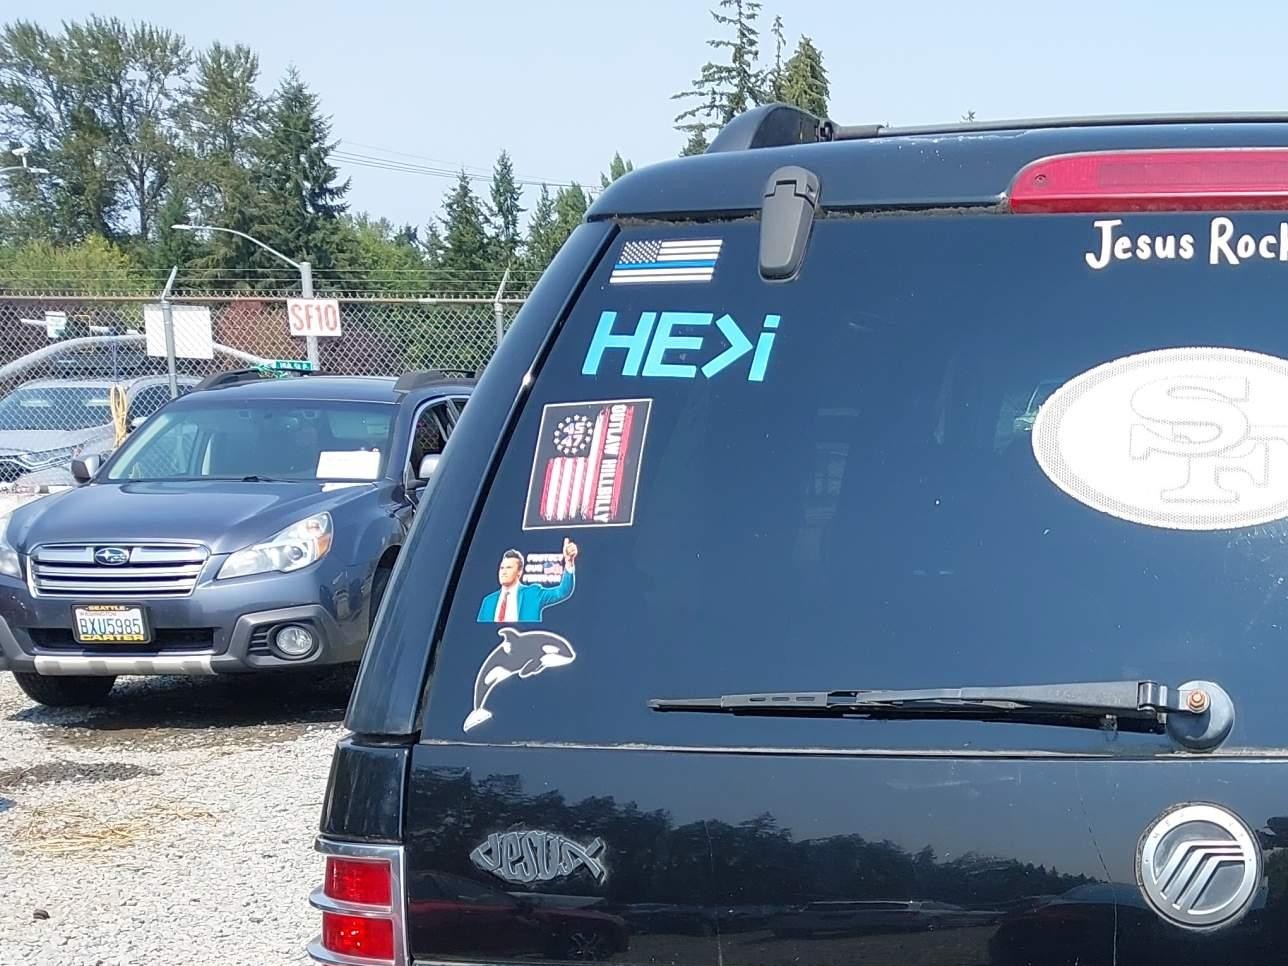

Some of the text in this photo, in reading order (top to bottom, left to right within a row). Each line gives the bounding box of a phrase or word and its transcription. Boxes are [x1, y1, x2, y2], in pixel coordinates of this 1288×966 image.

[1085, 219, 1195, 269] Jesus
[290, 304, 338, 331] SF10
[561, 434, 583, 447] 47
[593, 404, 627, 523] OUTLAW HILLBILLY
[80, 618, 142, 635] BXU5985
